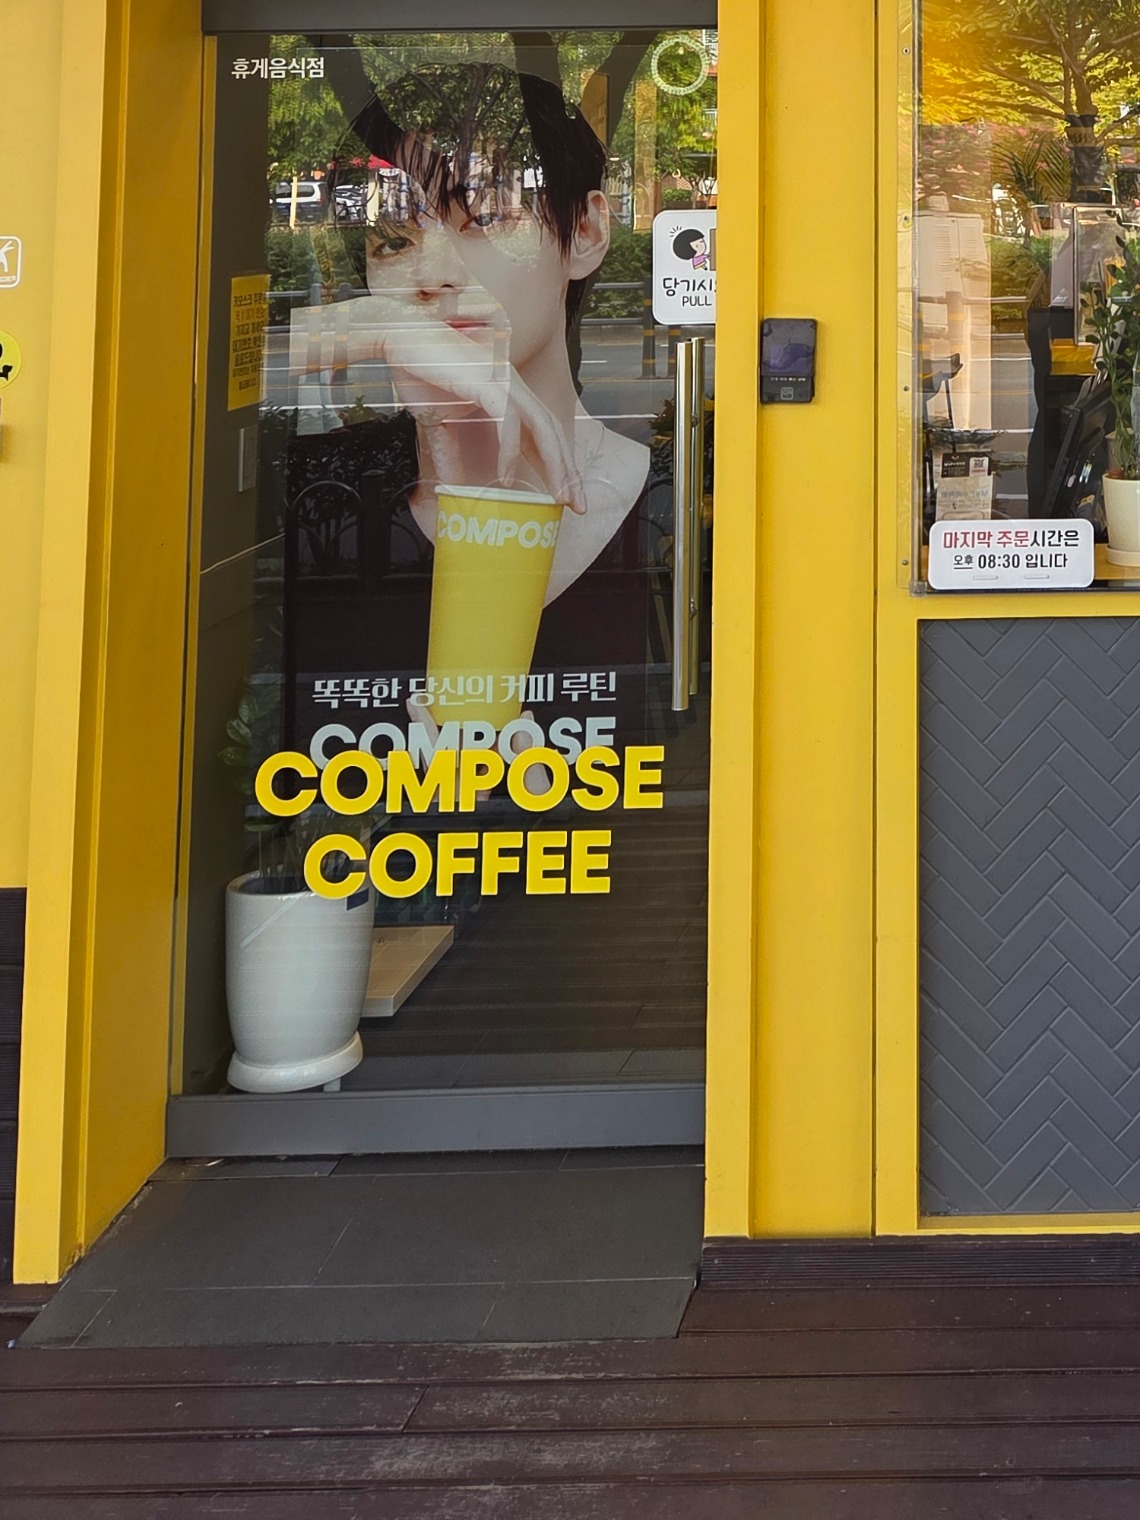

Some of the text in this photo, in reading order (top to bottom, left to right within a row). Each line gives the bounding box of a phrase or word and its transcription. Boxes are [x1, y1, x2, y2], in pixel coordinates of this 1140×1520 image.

[231, 57, 325, 80] 휴게음식점
[663, 277, 717, 297] 당기시
[682, 295, 712, 307] PULL
[943, 530, 1080, 549] 마지막 주문시간은
[953, 553, 1068, 569] 오후 08:30 입니다
[312, 671, 617, 709] 똑똑한 당신의 커피 루틴
[254, 744, 666, 817] COMPOSE
[303, 829, 612, 900] COFFEE
